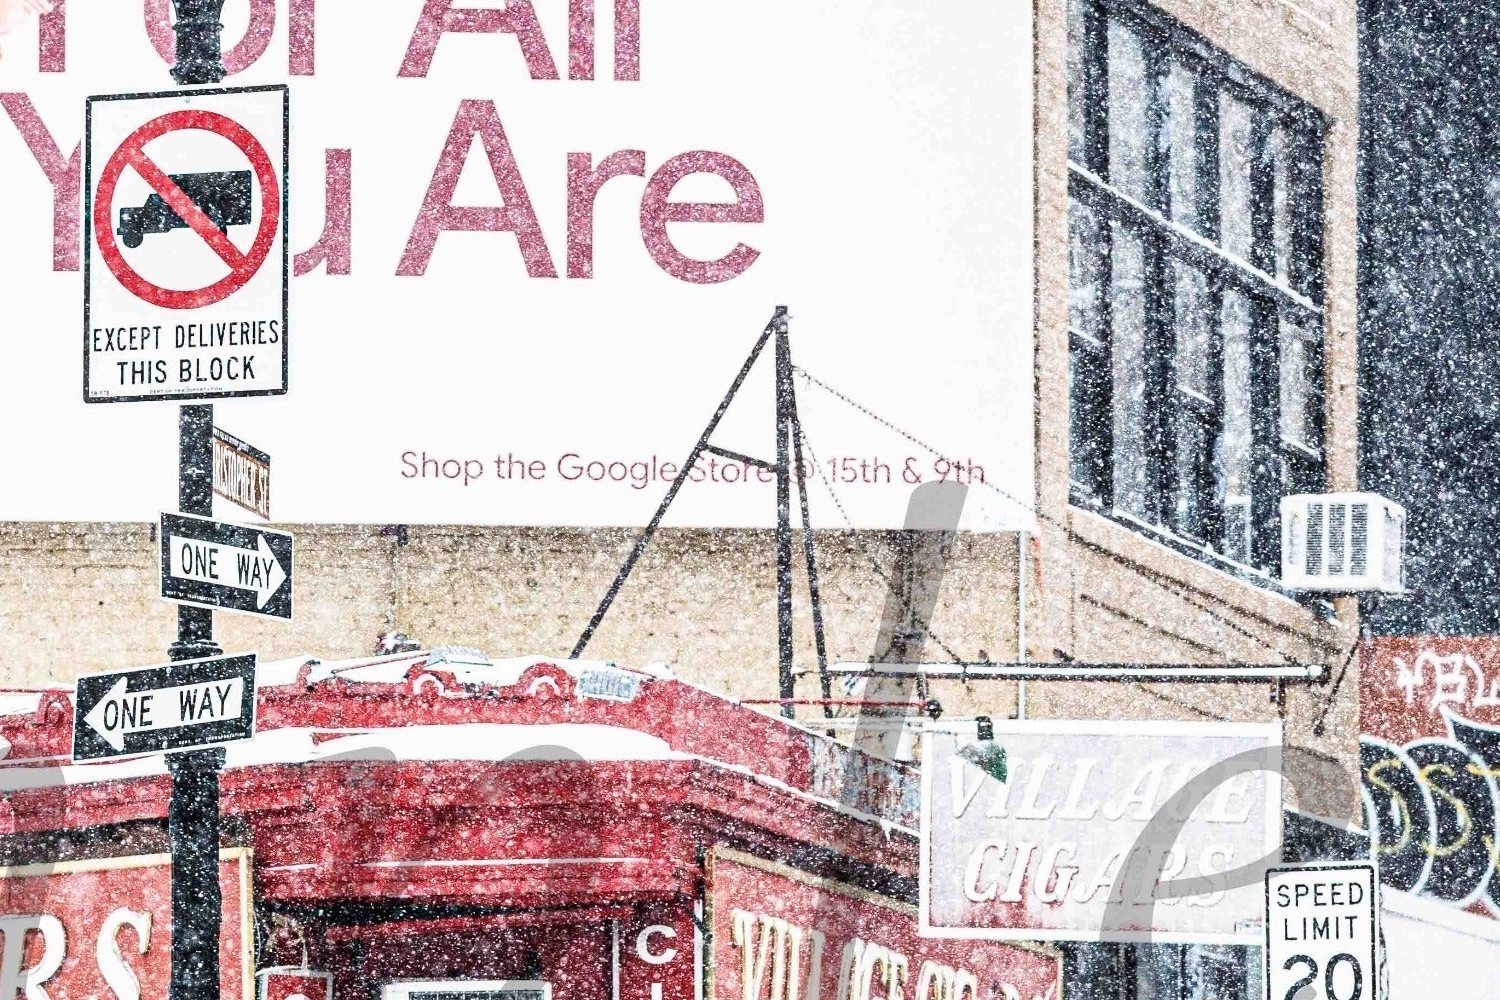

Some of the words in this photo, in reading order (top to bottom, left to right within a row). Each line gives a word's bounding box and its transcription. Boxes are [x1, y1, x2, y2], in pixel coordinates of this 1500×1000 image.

[394, 99, 765, 285] Are
[93, 326, 162, 352] EXCEPT
[175, 320, 279, 349] DELIVERIES
[117, 360, 167, 385] THIS
[179, 355, 256, 382] BLOCK
[400, 451, 484, 486] Shop
[496, 451, 546, 480] the
[557, 452, 678, 490] Google
[686, 456, 775, 484] Store
[827, 457, 891, 484] 15th
[902, 458, 922, 484] &
[934, 457, 986, 484] 9th
[181, 543, 219, 580] ONE
[236, 553, 274, 590] WAY
[103, 695, 153, 731] ONE
[179, 684, 232, 722] WAY
[950, 757, 1261, 823] VILLAGE
[963, 840, 1235, 907] CIGARS
[1277, 881, 1364, 908] SPEED
[1284, 915, 1358, 941] LIMIT
